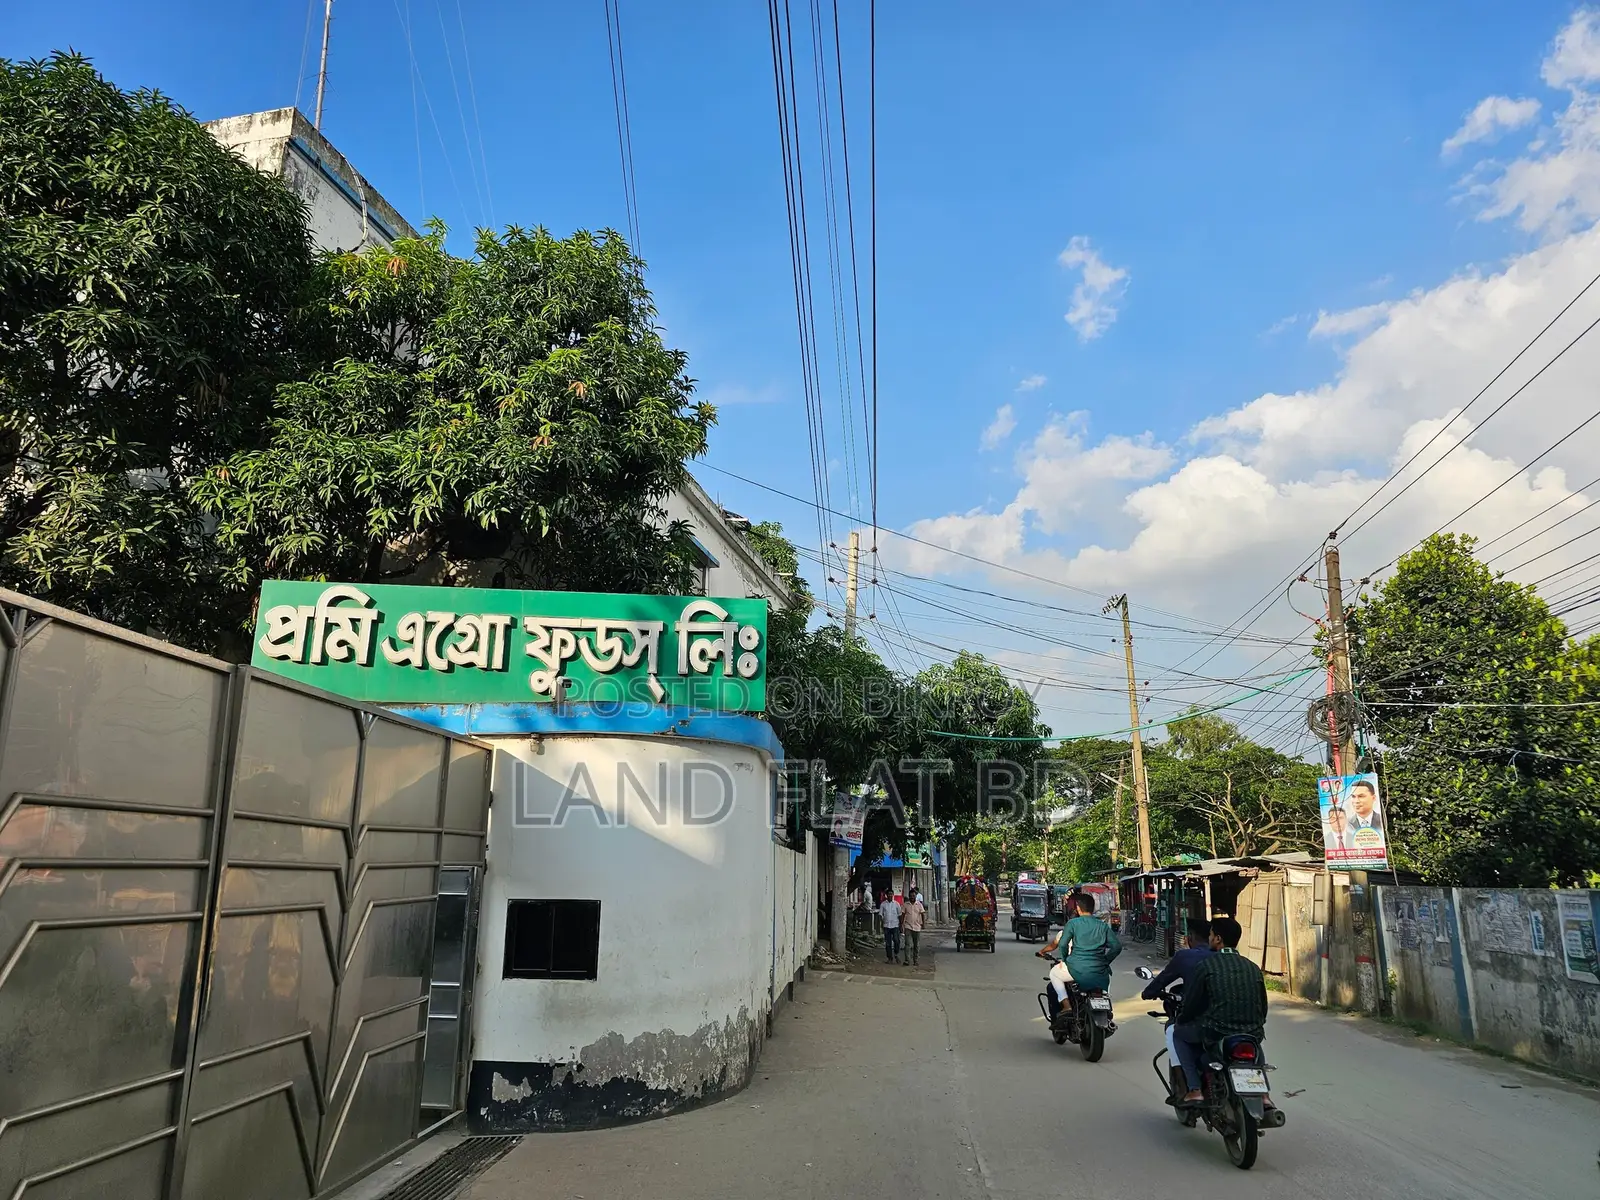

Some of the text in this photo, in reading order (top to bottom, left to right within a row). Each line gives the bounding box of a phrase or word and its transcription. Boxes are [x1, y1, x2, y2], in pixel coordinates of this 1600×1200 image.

[258, 585, 760, 703] প্রমি এগ্রো ফুডস্ লিঃ
